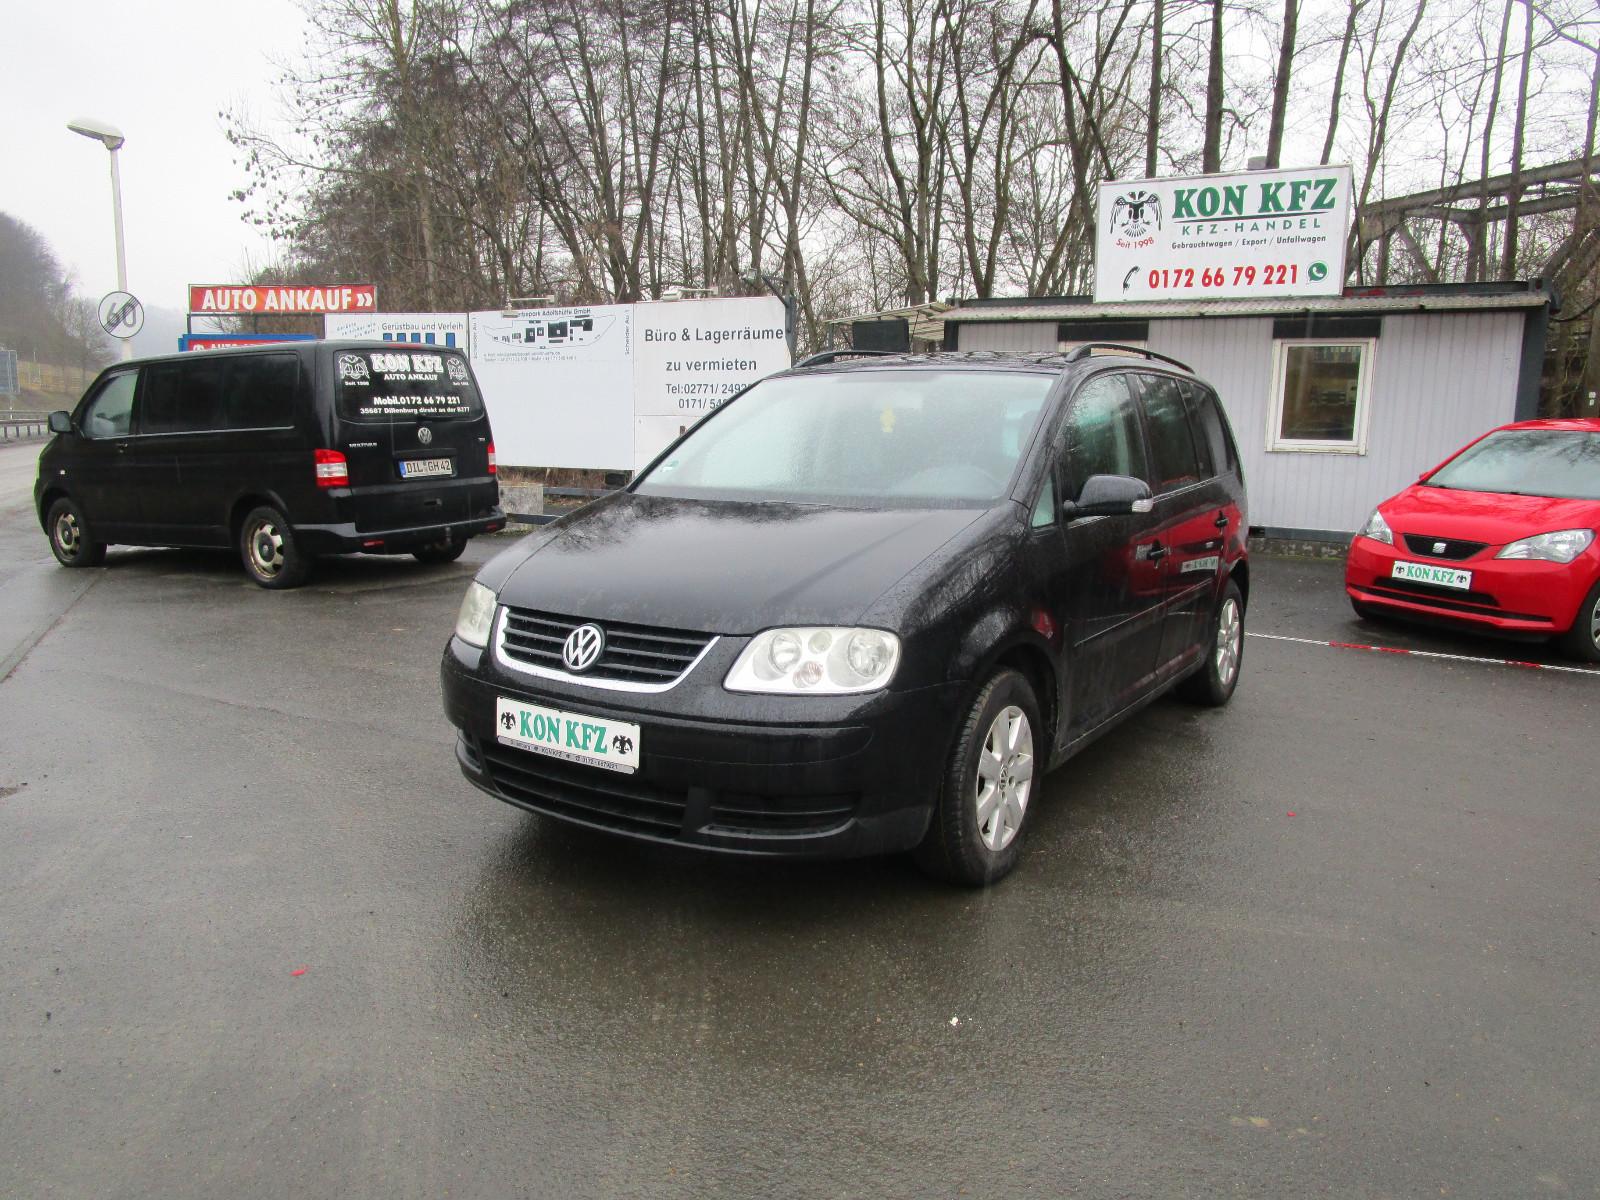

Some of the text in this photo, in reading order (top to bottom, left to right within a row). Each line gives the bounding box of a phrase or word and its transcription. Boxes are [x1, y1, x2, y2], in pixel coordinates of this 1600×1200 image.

[1172, 178, 1338, 219] KON KFZ
[1182, 218, 1321, 236] KFZ-HANDEL
[1116, 238, 1130, 248] Seit
[1172, 240, 1232, 250] Gebrauchtwagen
[1242, 237, 1267, 248] Export
[1276, 234, 1326, 245] Unfallwagen
[1148, 264, 1298, 289] 0172 66 79 221
[202, 288, 352, 311] AUTO ANKAUF
[382, 322, 420, 331] Gerüstbau
[422, 322, 436, 331] und
[437, 322, 464, 331] Verleih
[644, 326, 784, 344] Büro & Lagerräume
[370, 354, 444, 373] KON KFZ
[666, 357, 757, 372] zu vermieten
[424, 396, 434, 404] 66
[436, 396, 446, 405] 79
[447, 396, 460, 404] 221
[678, 398, 706, 409] 0171/
[384, 406, 418, 415] Dillenburg
[406, 462, 424, 474] DIL
[1406, 565, 1456, 584] KON KFZ
[520, 710, 608, 754] KON KFZ
